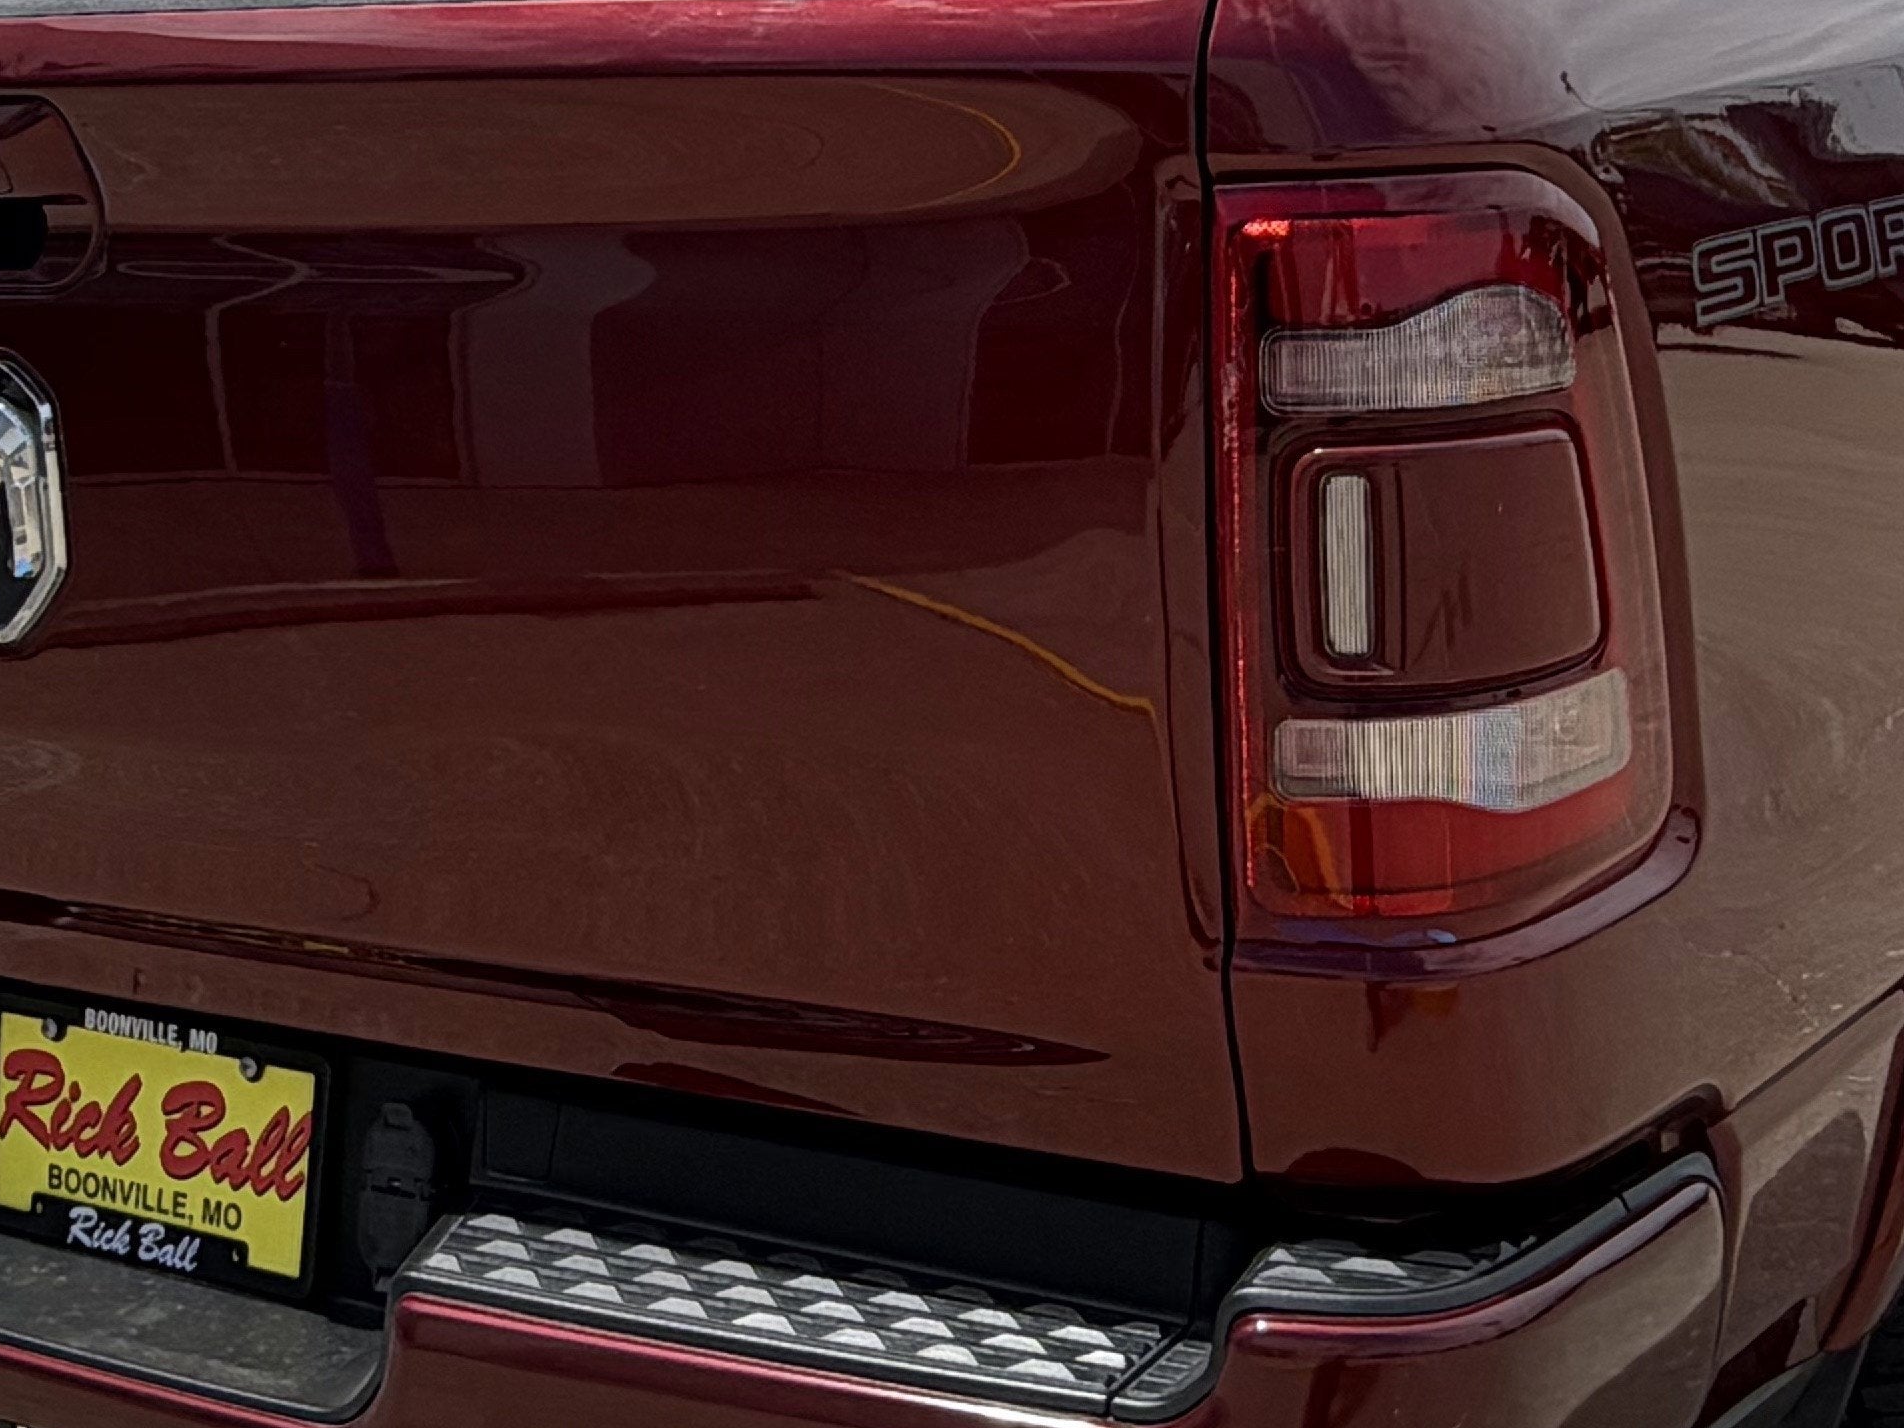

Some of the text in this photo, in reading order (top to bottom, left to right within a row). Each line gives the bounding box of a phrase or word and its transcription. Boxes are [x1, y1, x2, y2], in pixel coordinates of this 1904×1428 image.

[84, 1008, 218, 1054] BOONVILLE, MO
[160, 1080, 313, 1201] Ball
[48, 1163, 242, 1231] BOONVILLE, MO
[67, 1205, 201, 1272] Rick Ball
